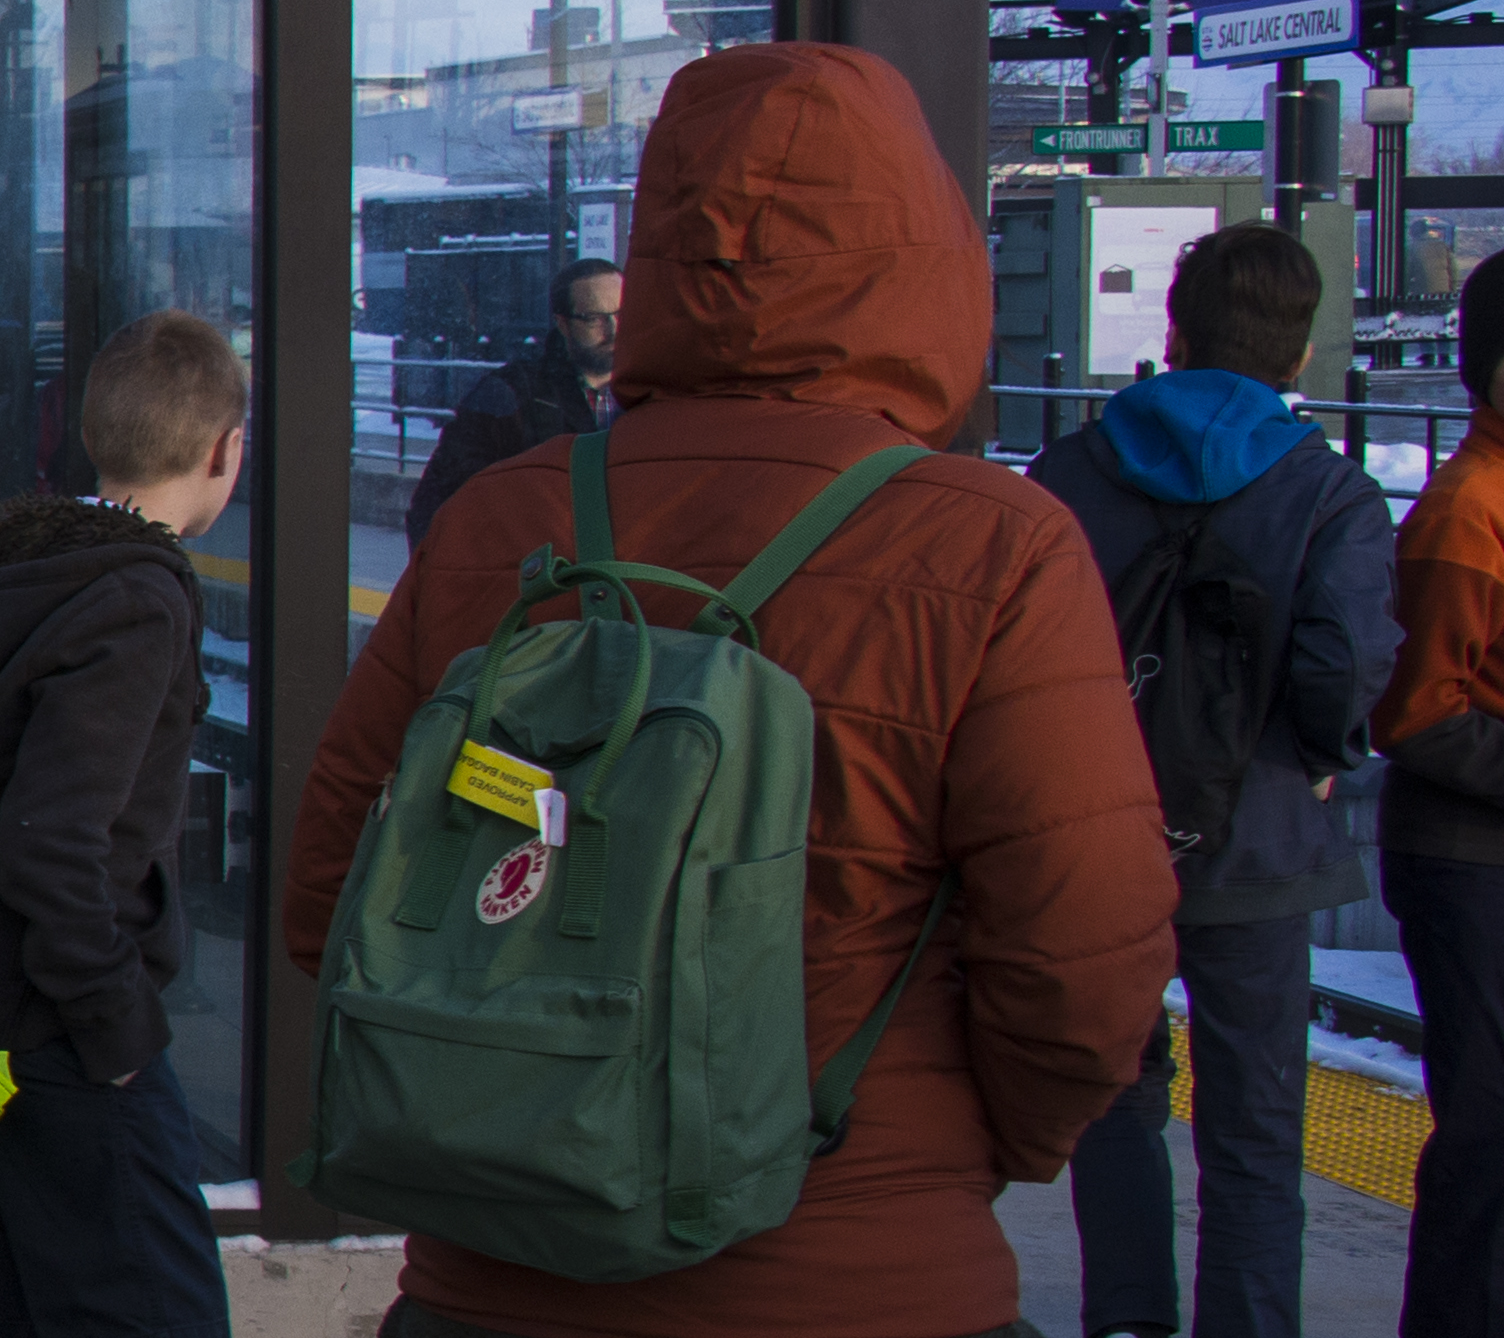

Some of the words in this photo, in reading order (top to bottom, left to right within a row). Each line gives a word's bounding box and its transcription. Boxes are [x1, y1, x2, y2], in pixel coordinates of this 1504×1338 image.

[1218, 21, 1247, 50] SALT
[1249, 15, 1282, 45] LAKE
[1284, 7, 1341, 40] CENTRAL
[1059, 128, 1142, 150] FRONTRUNNER
[1174, 126, 1219, 147] TRAX
[467, 776, 529, 807] APPROVED
[499, 771, 536, 793] CABIN
